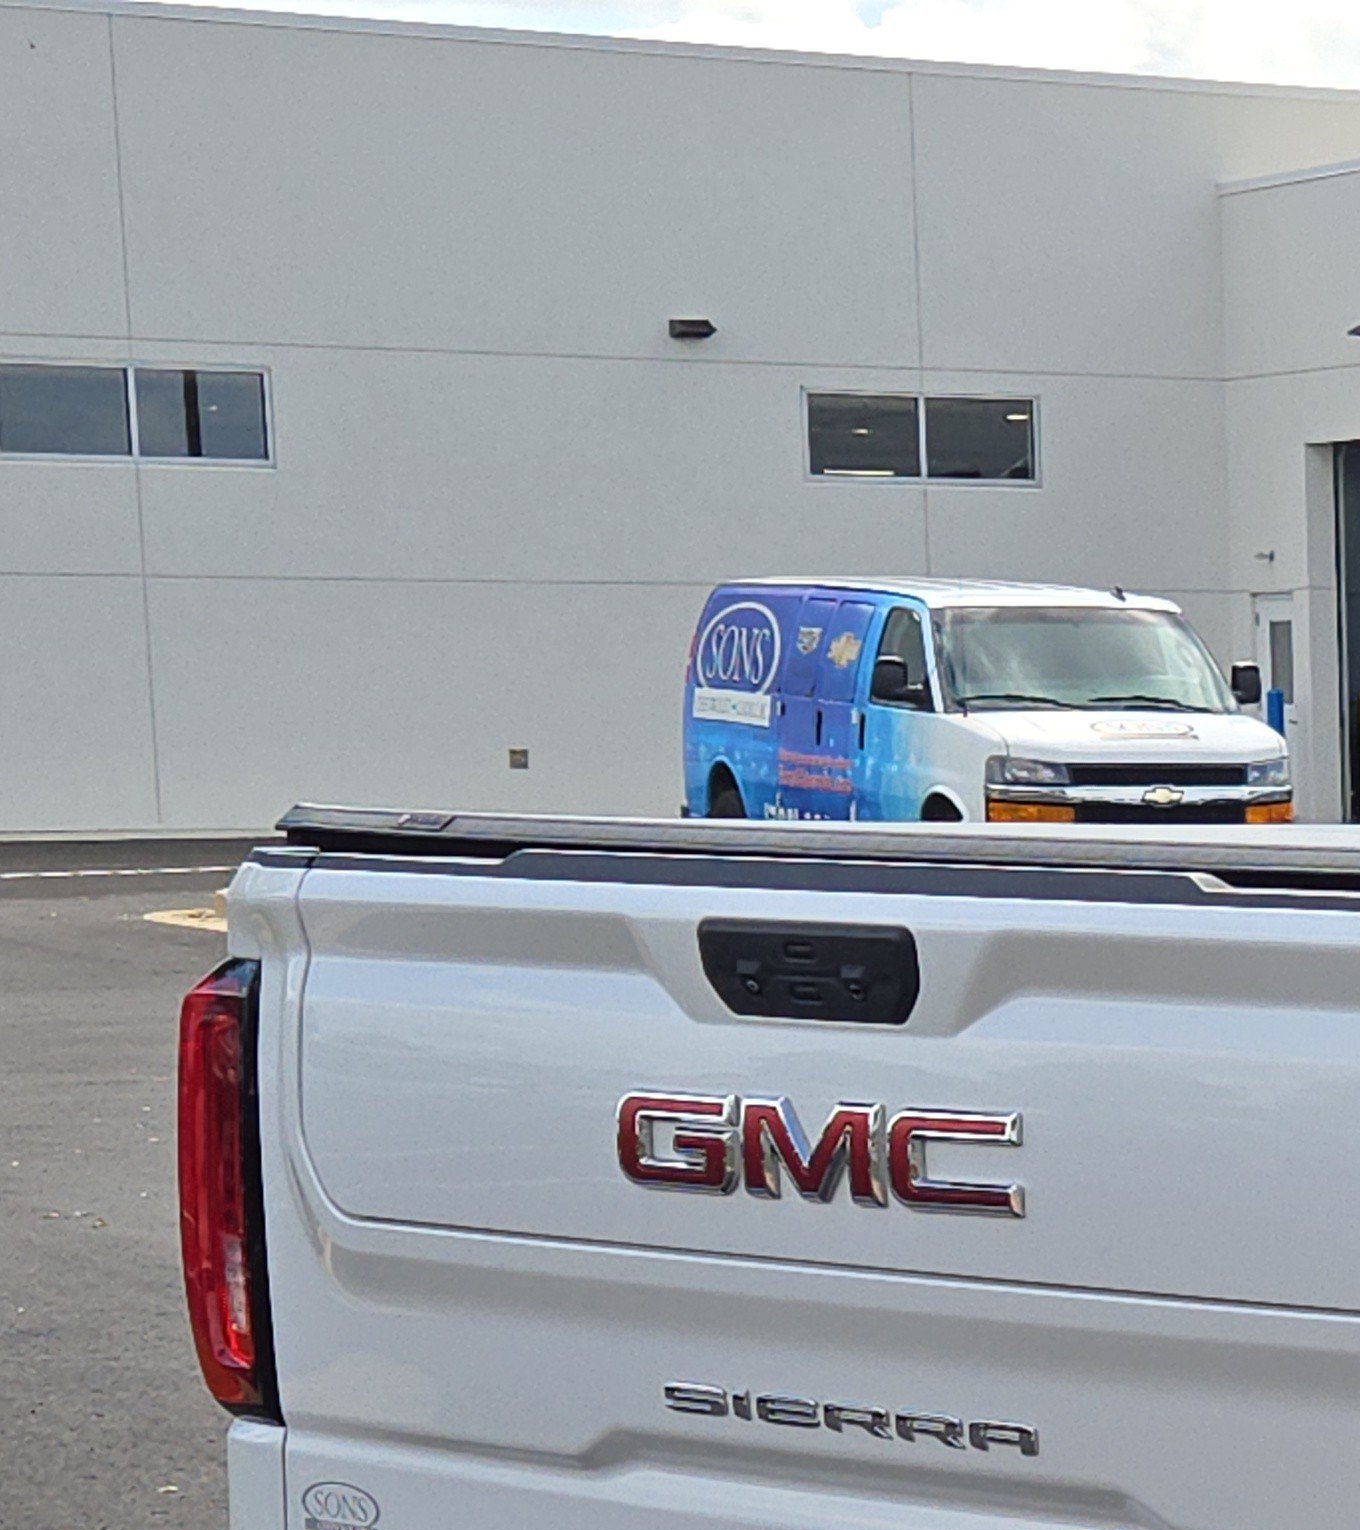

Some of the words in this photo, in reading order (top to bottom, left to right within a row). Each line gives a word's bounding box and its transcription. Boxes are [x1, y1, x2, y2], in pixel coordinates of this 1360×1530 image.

[706, 623, 770, 684] SONS
[616, 1089, 1026, 1219] GMC
[663, 1379, 1039, 1456] SIERRA
[313, 1490, 369, 1522] SONS
